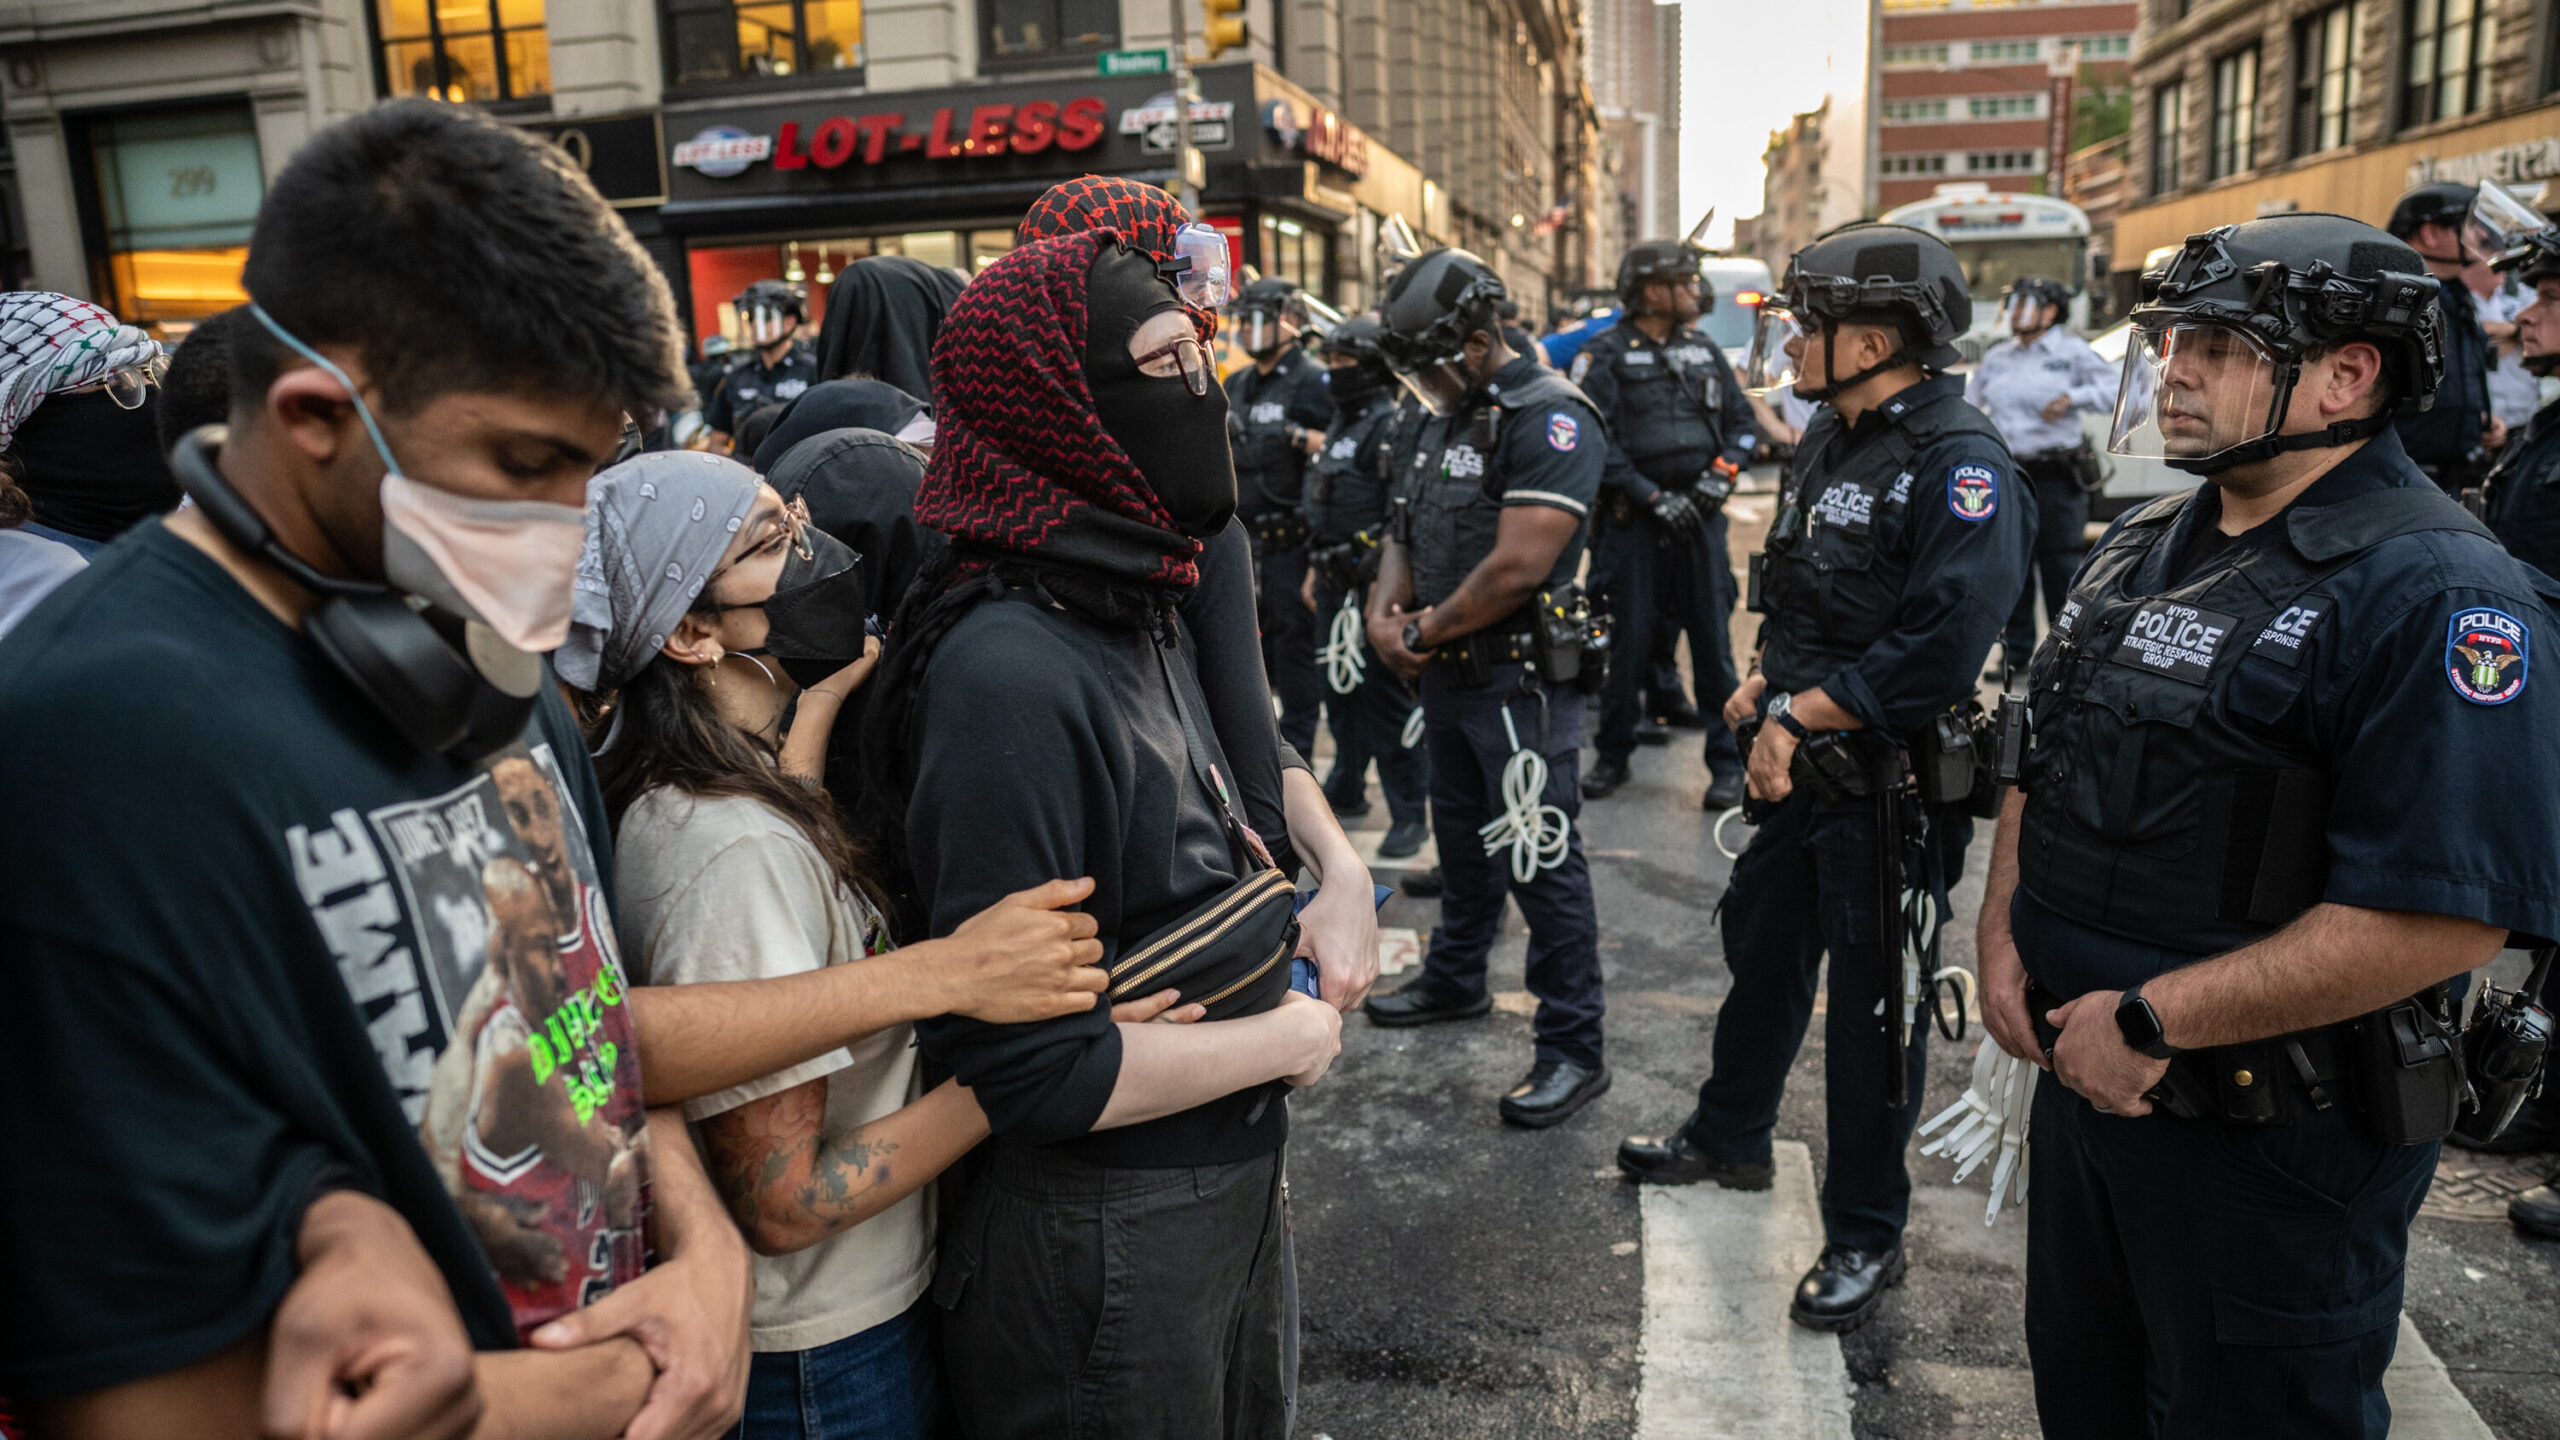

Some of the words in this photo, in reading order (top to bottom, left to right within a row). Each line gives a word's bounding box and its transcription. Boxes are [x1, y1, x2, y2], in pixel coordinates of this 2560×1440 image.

[774, 97, 1106, 170] LOT-LESS
[169, 166, 216, 198] 299
[1955, 466, 1992, 482] POLICE
[1819, 487, 1874, 514] POLICE
[2166, 605, 2198, 621] NYPD
[2269, 606, 2319, 637] CE
[2130, 610, 2224, 654] POLICE
[2260, 629, 2301, 649] ESPONSE
[2459, 613, 2521, 642] POLICE
[2479, 634, 2502, 644] NYPD
[2122, 635, 2165, 654] STRATEGIC
[2163, 645, 2213, 668] RESPONSE
[2142, 652, 2175, 669] GROUP
